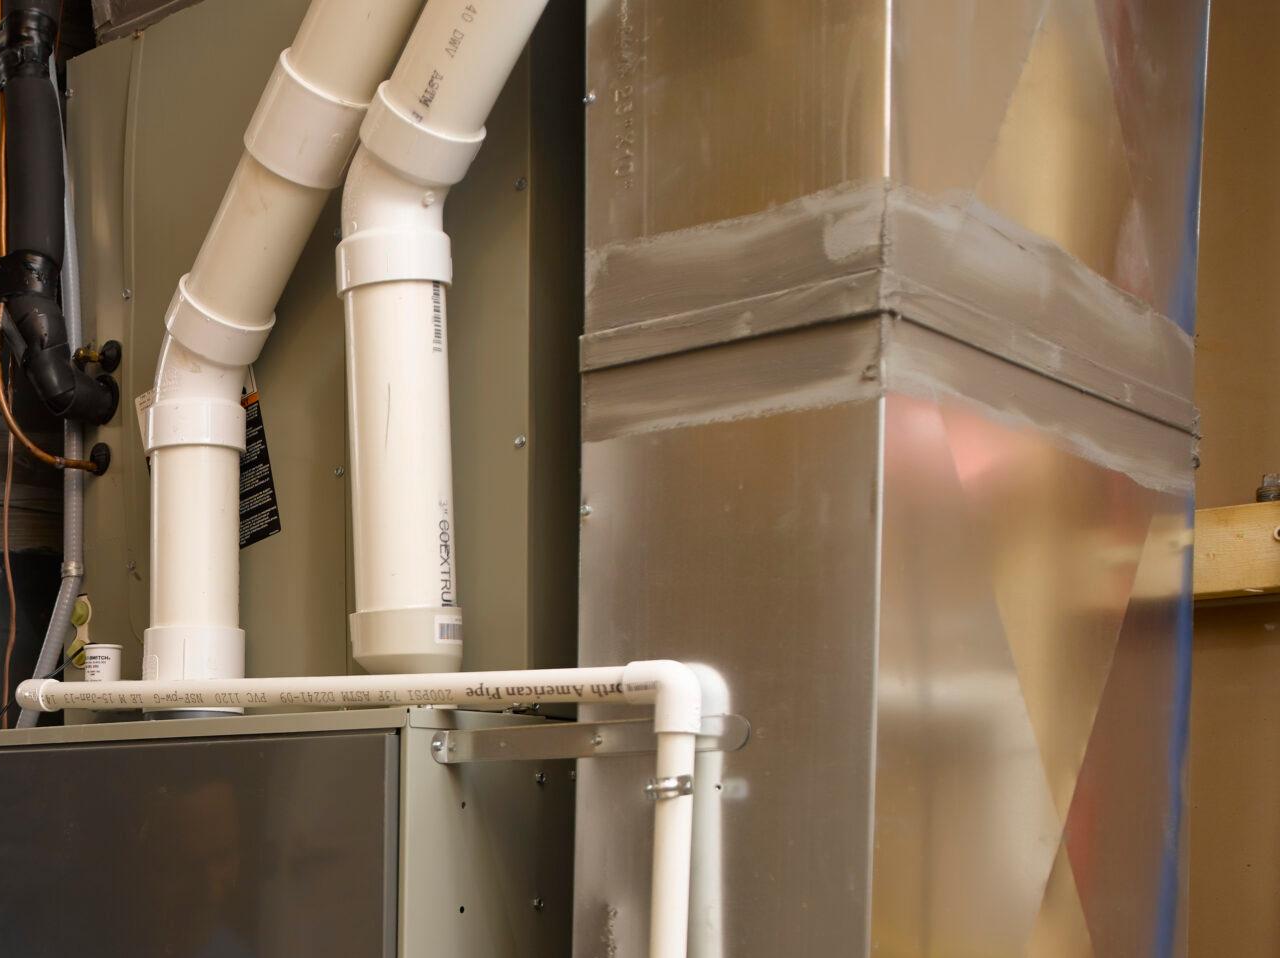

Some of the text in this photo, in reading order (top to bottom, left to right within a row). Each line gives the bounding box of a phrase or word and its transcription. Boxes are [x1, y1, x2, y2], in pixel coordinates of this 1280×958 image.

[444, 28, 465, 58] DWV
[418, 69, 444, 108] ASTM
[153, 690, 204, 704] NSF-pw-G
[341, 691, 370, 703] ASTM
[378, 690, 400, 702] 73F
[408, 689, 453, 701] 200PSI
[465, 683, 500, 700] Pipe
[502, 684, 585, 701] American
[591, 682, 623, 699] orth
[64, 692, 113, 705] 15-Jan-13
[215, 692, 240, 704] 1120
[246, 692, 267, 703] PVC
[280, 691, 335, 704] D2241-09
